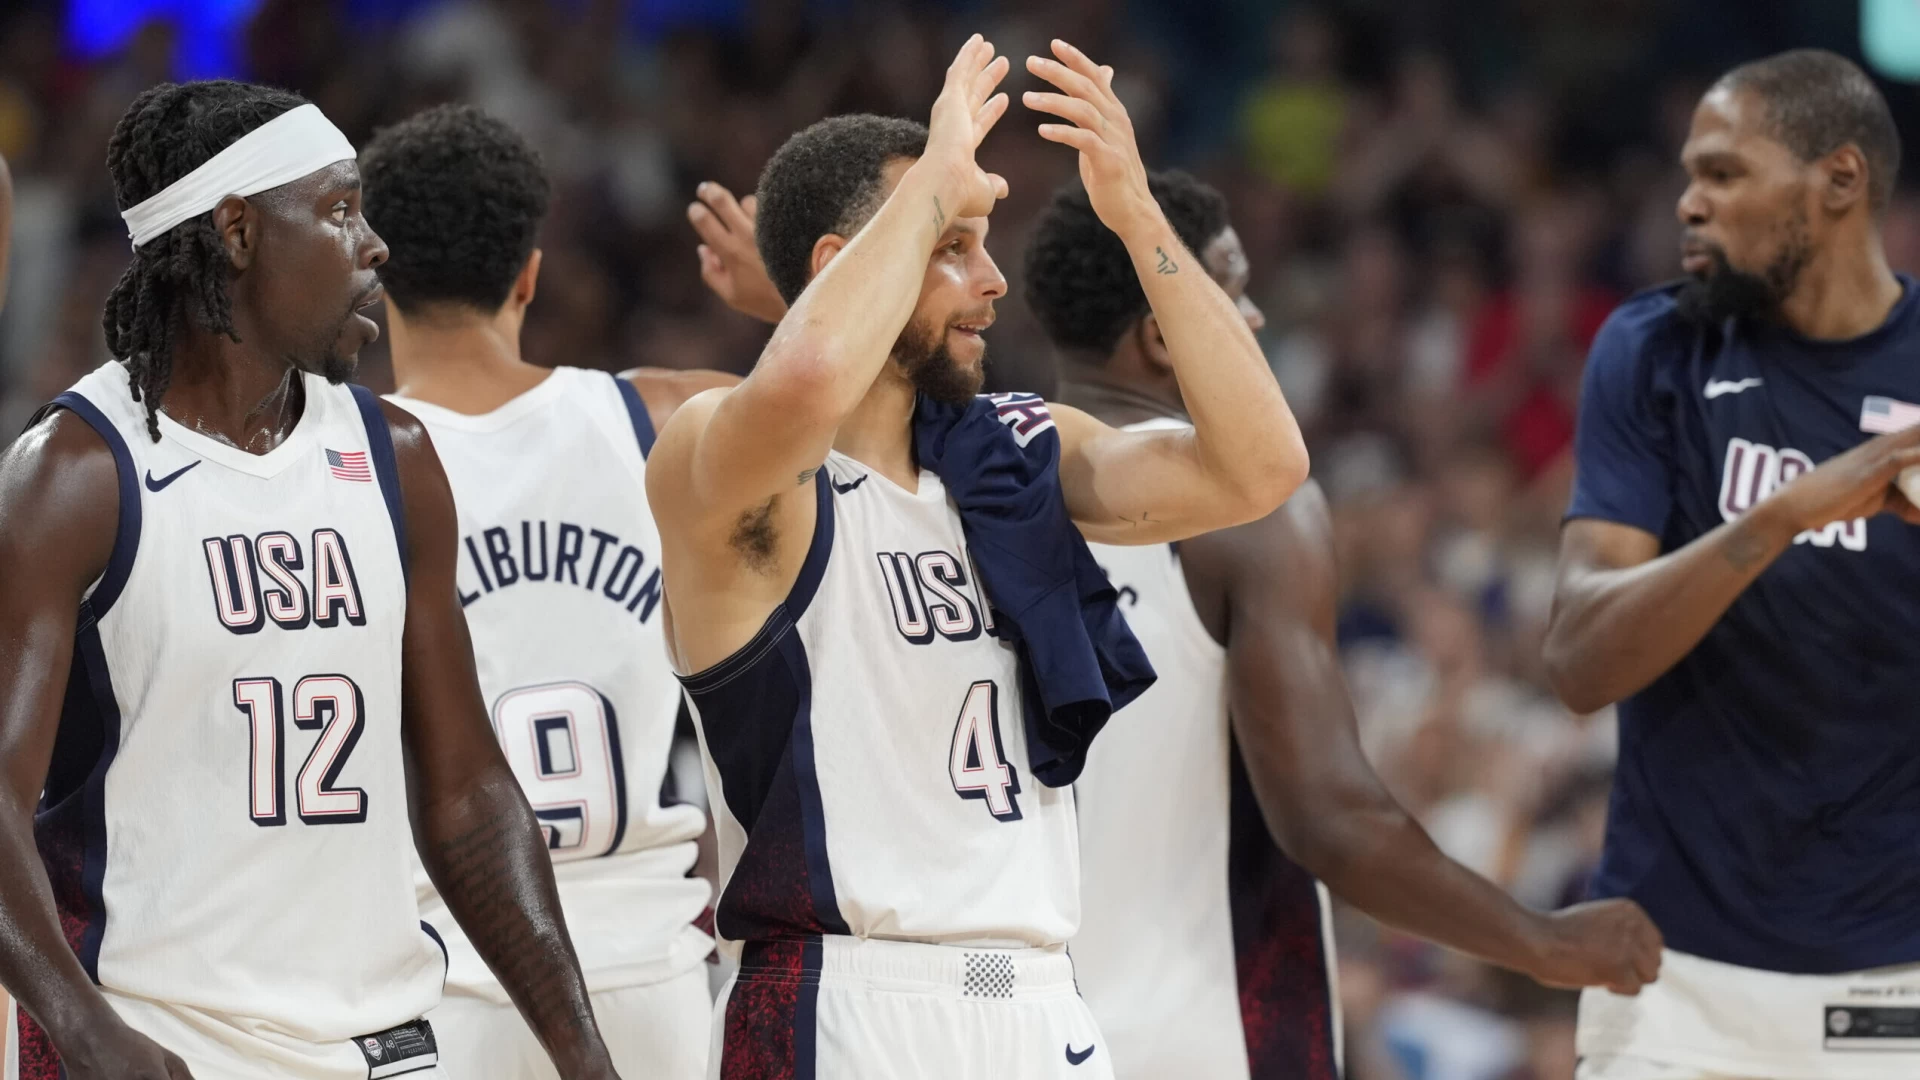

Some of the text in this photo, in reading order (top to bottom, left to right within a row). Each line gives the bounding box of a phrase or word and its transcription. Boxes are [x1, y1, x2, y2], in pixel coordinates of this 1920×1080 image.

[203, 528, 367, 635] USA
[233, 673, 368, 827] 12
[492, 680, 628, 865] 9
[948, 679, 1023, 823] 4
